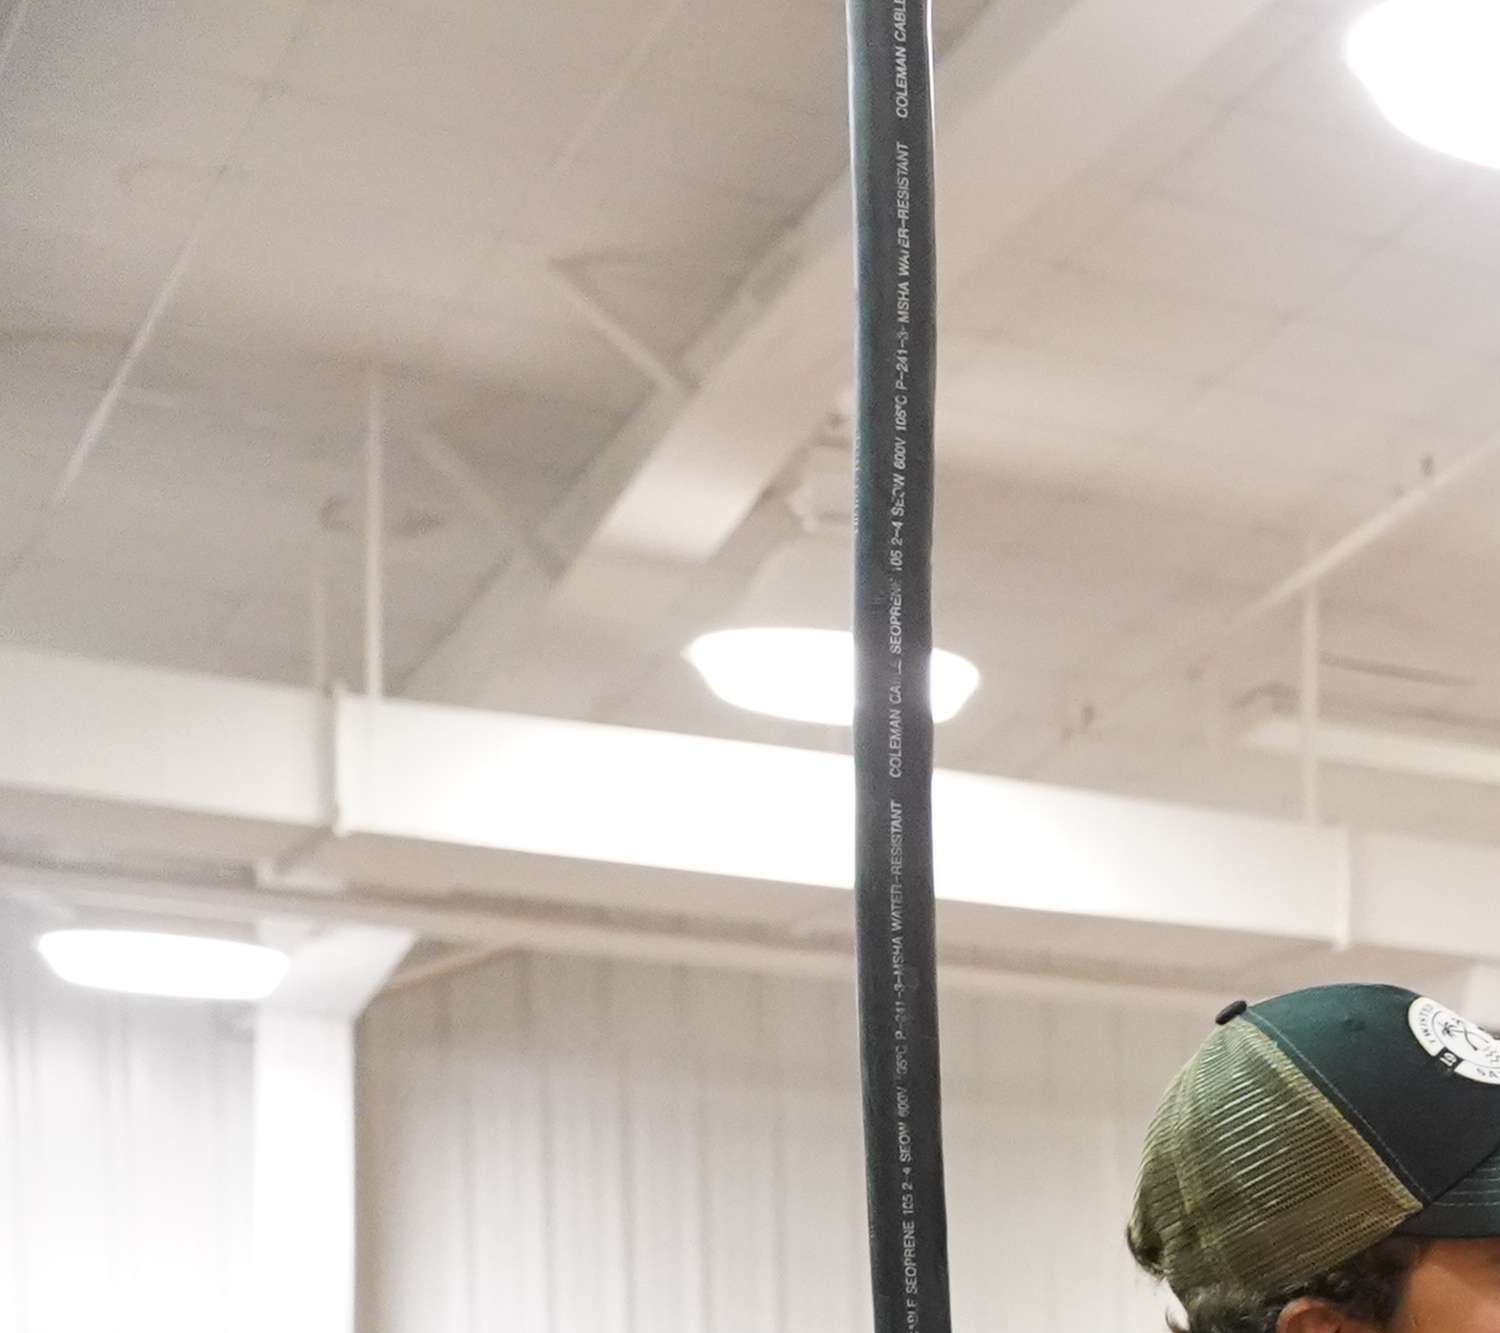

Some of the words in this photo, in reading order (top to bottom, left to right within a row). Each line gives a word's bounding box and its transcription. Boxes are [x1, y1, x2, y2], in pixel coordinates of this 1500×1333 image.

[895, 46, 909, 118] COLEMAN
[893, 436, 907, 469] 600V
[888, 577, 902, 654] SEOPREN
[888, 709, 903, 778] COLEMAN
[890, 801, 904, 931] WATER-RESISTANT
[897, 1122, 912, 1162] SEOW
[902, 1194, 915, 1215] 105
[902, 1220, 919, 1294] SEOPRENE
